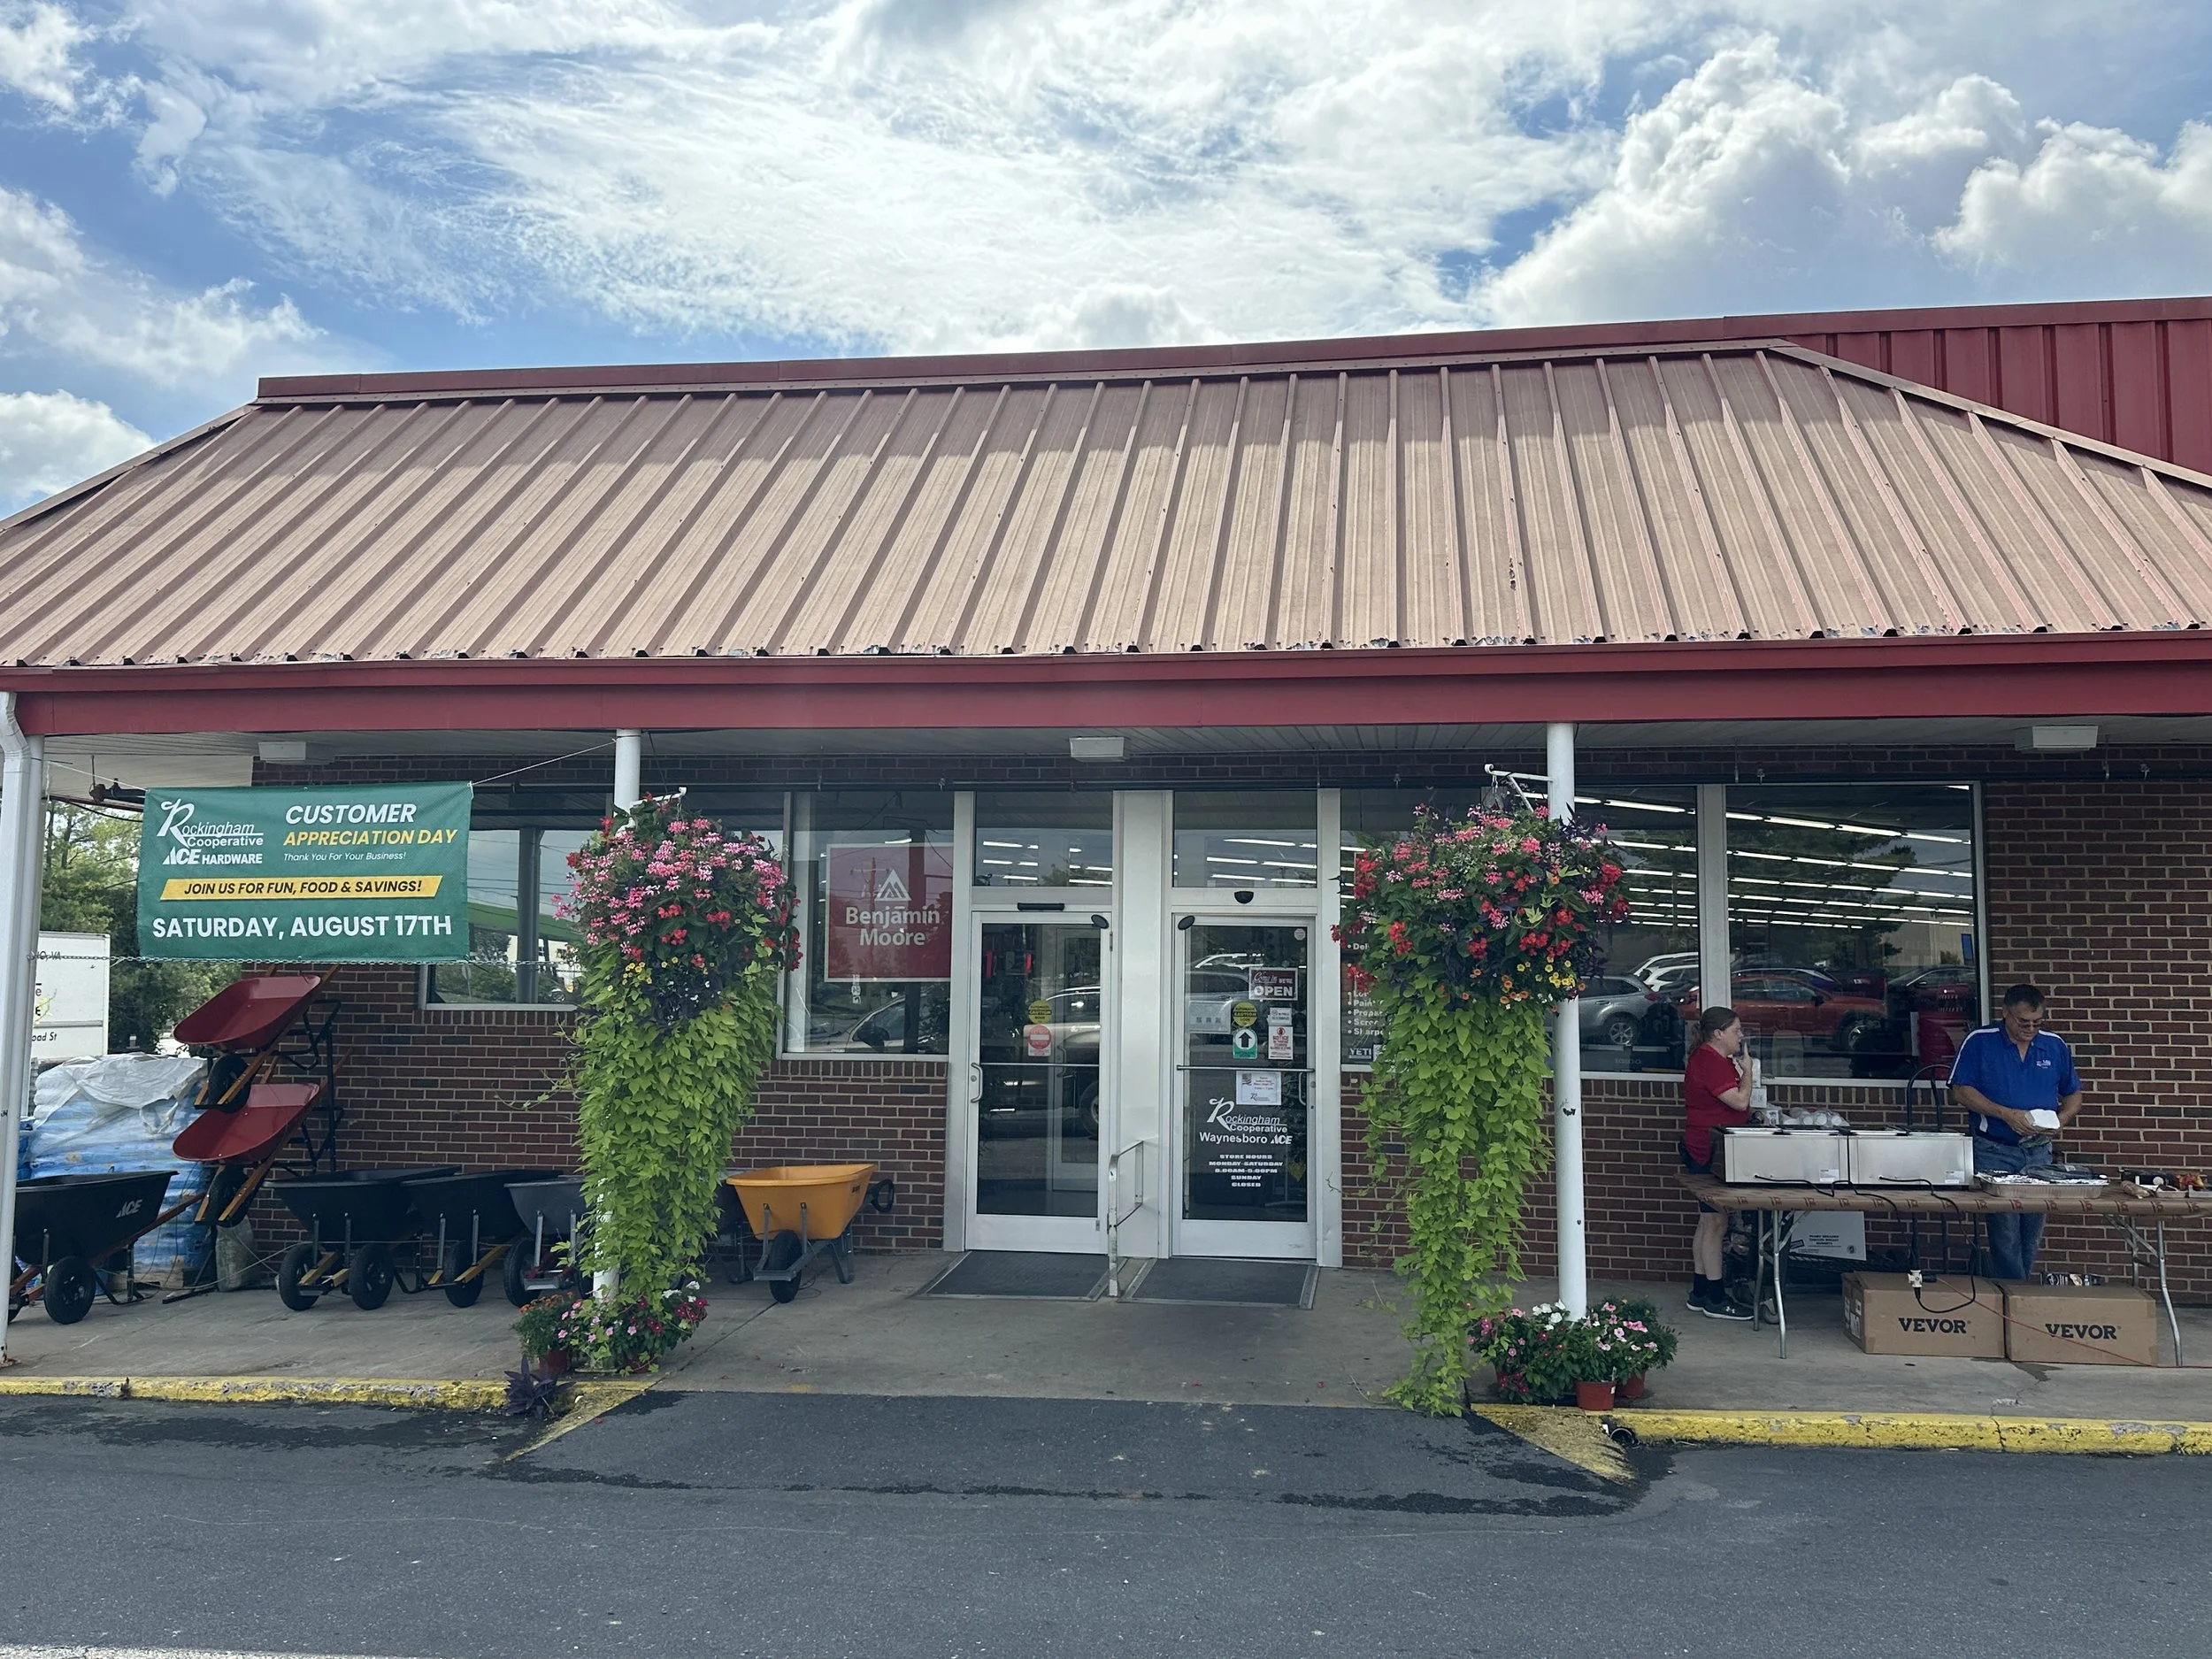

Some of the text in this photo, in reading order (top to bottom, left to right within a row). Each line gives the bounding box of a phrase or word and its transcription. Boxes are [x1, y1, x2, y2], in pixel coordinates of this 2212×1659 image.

[286, 803, 417, 825] CUSTOMER
[157, 798, 258, 848] Rockingham
[188, 836, 264, 849] Cooperative
[283, 829, 457, 846] APPRECIATION DAY
[163, 846, 263, 865] ACE HARDWARE
[365, 851, 406, 860] Business!
[184, 880, 422, 895] JOIN US FOR FUN, FOOD & SAVINGS!
[846, 906, 940, 929] Benjamin
[152, 915, 452, 940] SATURDAY, AUGUST 17TH
[860, 929, 926, 946] Moore
[1254, 986, 1293, 996] OPEN
[50, 1032, 58, 1041] St
[1207, 1097, 1283, 1132] Rockingham
[1230, 1124, 1288, 1133] Cooperative
[1200, 1132, 1293, 1145] Waynesboro ACE
[116, 1199, 142, 1218] ACE
[1899, 1317, 1967, 1334] VEVOR
[2046, 1324, 2117, 1340] VEVOR
